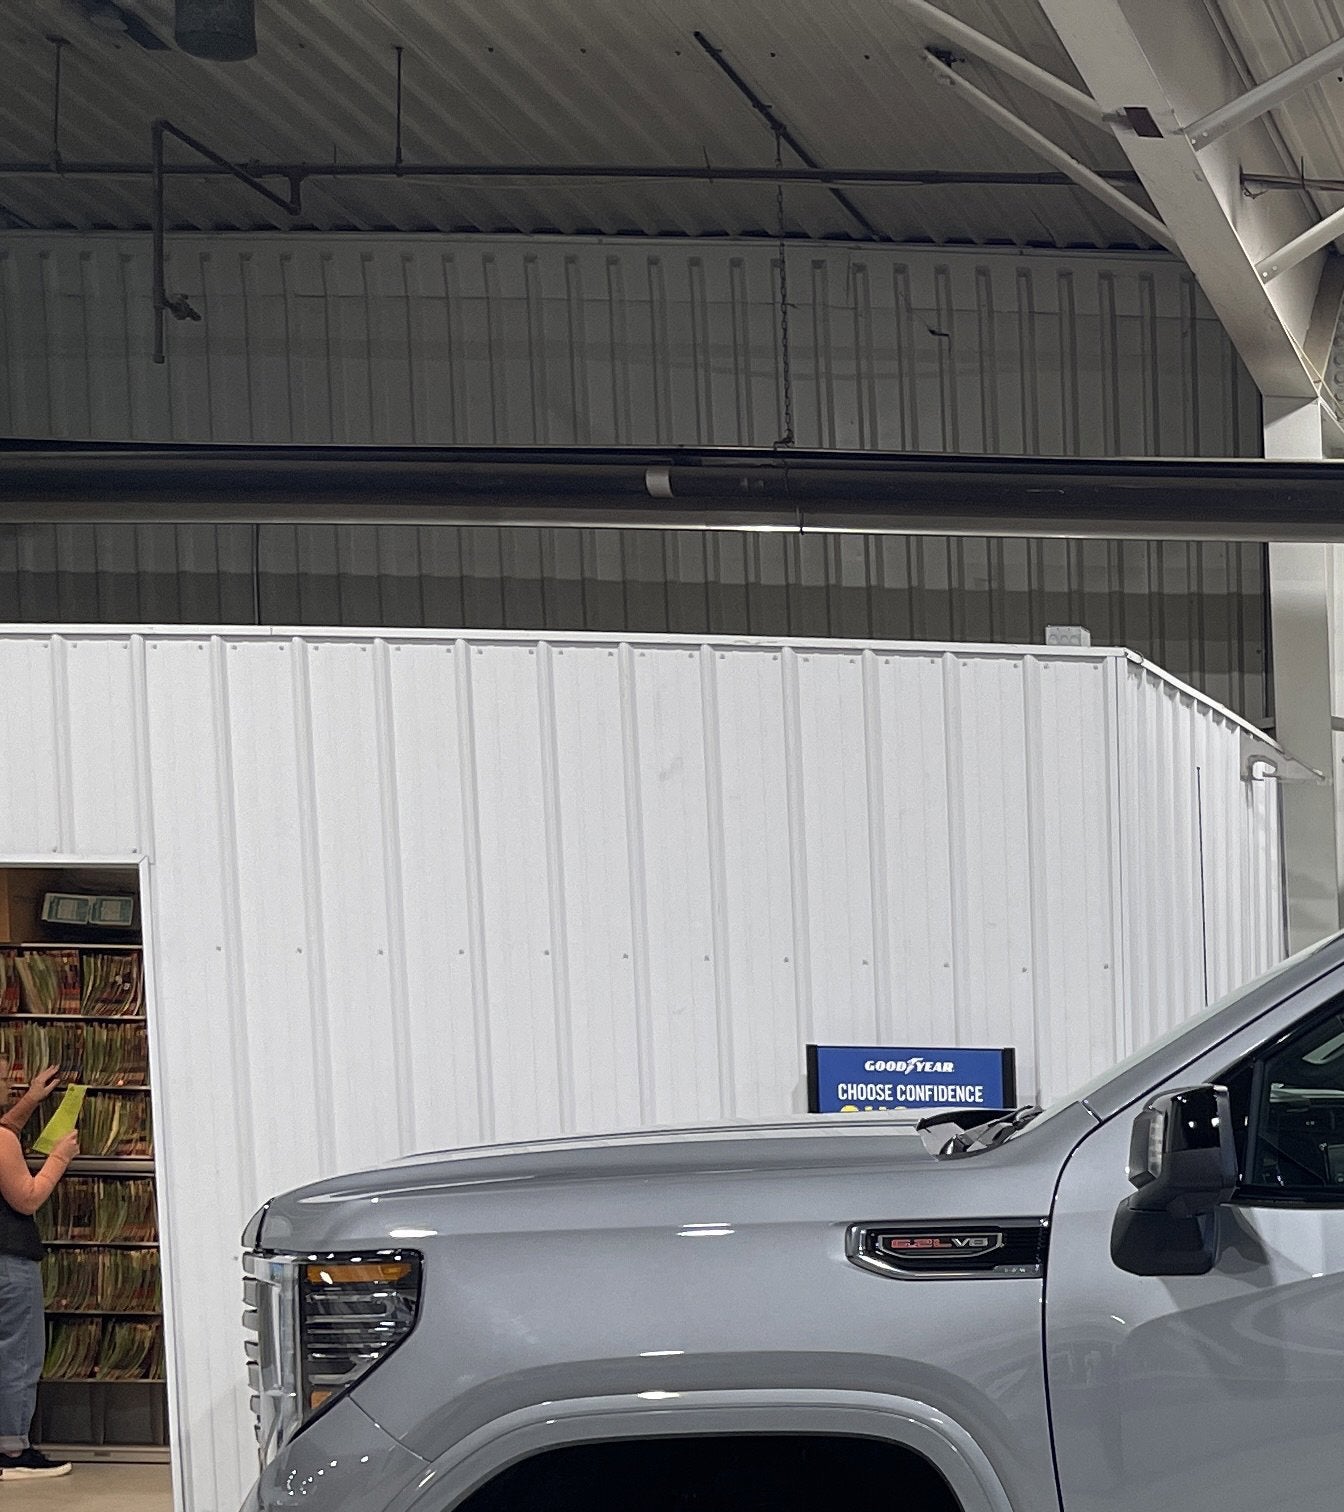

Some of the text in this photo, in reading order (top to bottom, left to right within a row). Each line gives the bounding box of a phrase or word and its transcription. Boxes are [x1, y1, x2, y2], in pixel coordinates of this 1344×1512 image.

[864, 1057, 954, 1075] GOODYEAR
[838, 1083, 983, 1103] CHOOSE CONFIDENCE
